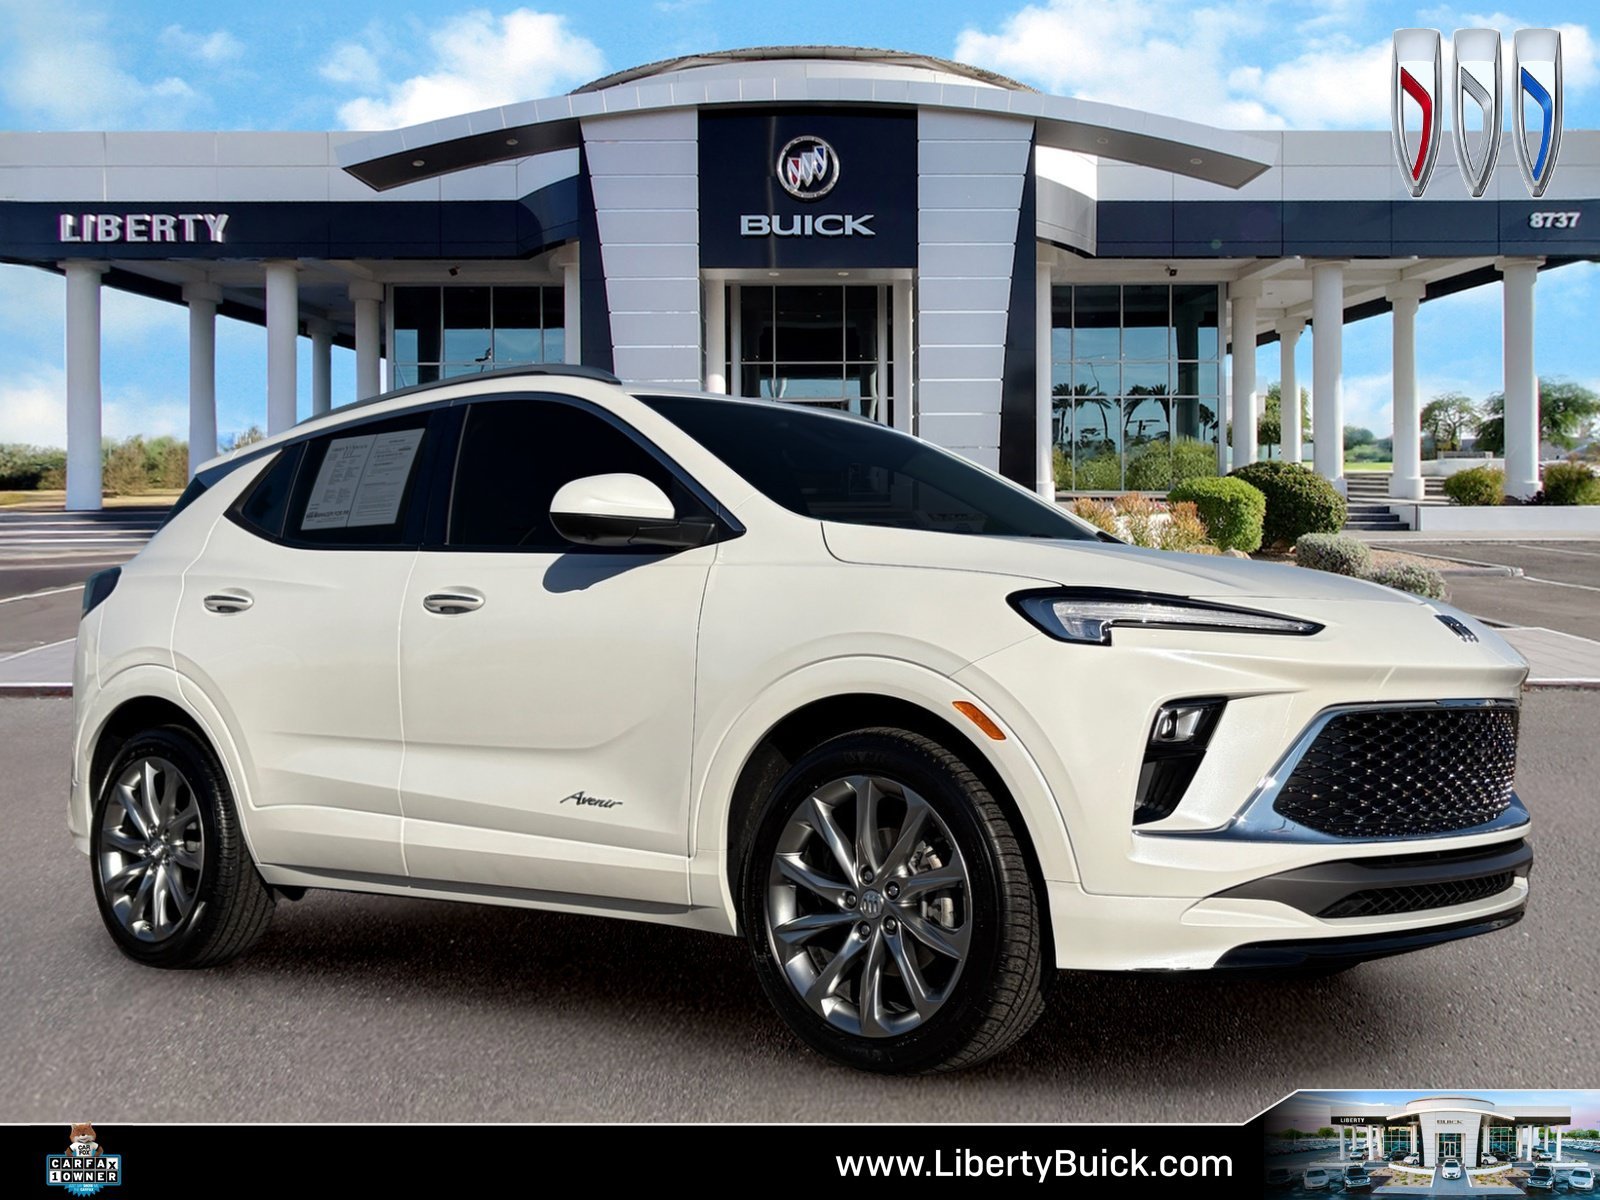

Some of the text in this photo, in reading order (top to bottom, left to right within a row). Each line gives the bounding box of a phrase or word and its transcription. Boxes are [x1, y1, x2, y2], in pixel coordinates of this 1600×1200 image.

[59, 213, 229, 242] LIBERTY
[740, 214, 876, 236] BUICK
[1529, 211, 1581, 229] 8737
[559, 790, 623, 809] Avenir
